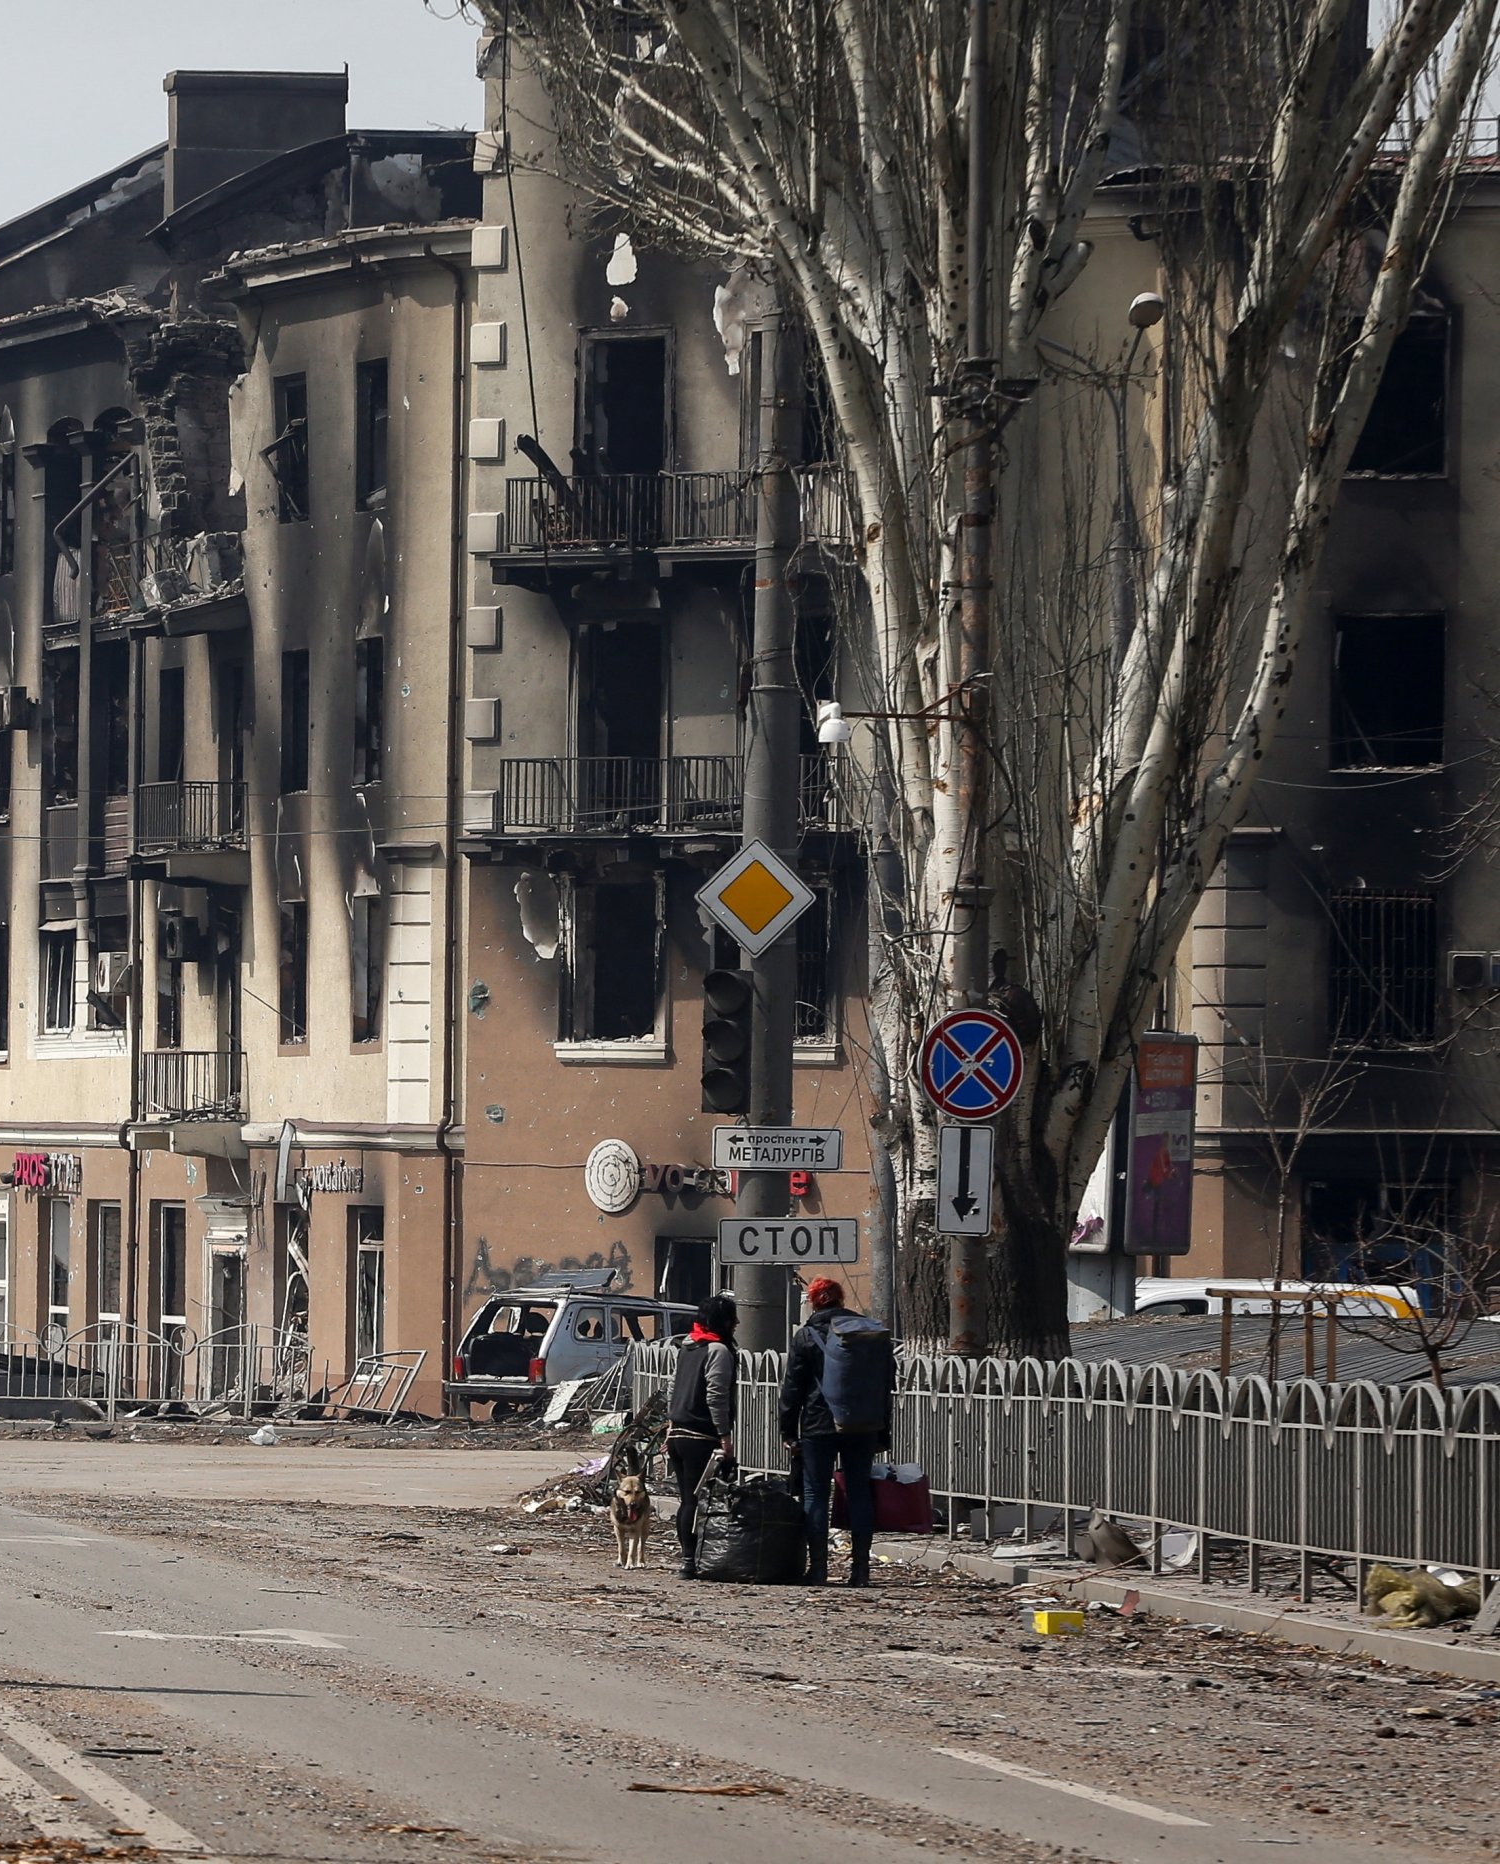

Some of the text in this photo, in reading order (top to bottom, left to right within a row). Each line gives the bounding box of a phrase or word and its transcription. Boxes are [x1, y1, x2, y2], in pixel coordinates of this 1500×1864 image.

[748, 1135, 806, 1146] проспект
[729, 1147, 825, 1163] МЕТАЛУРГІВ
[738, 1225, 839, 1256] СТОП
